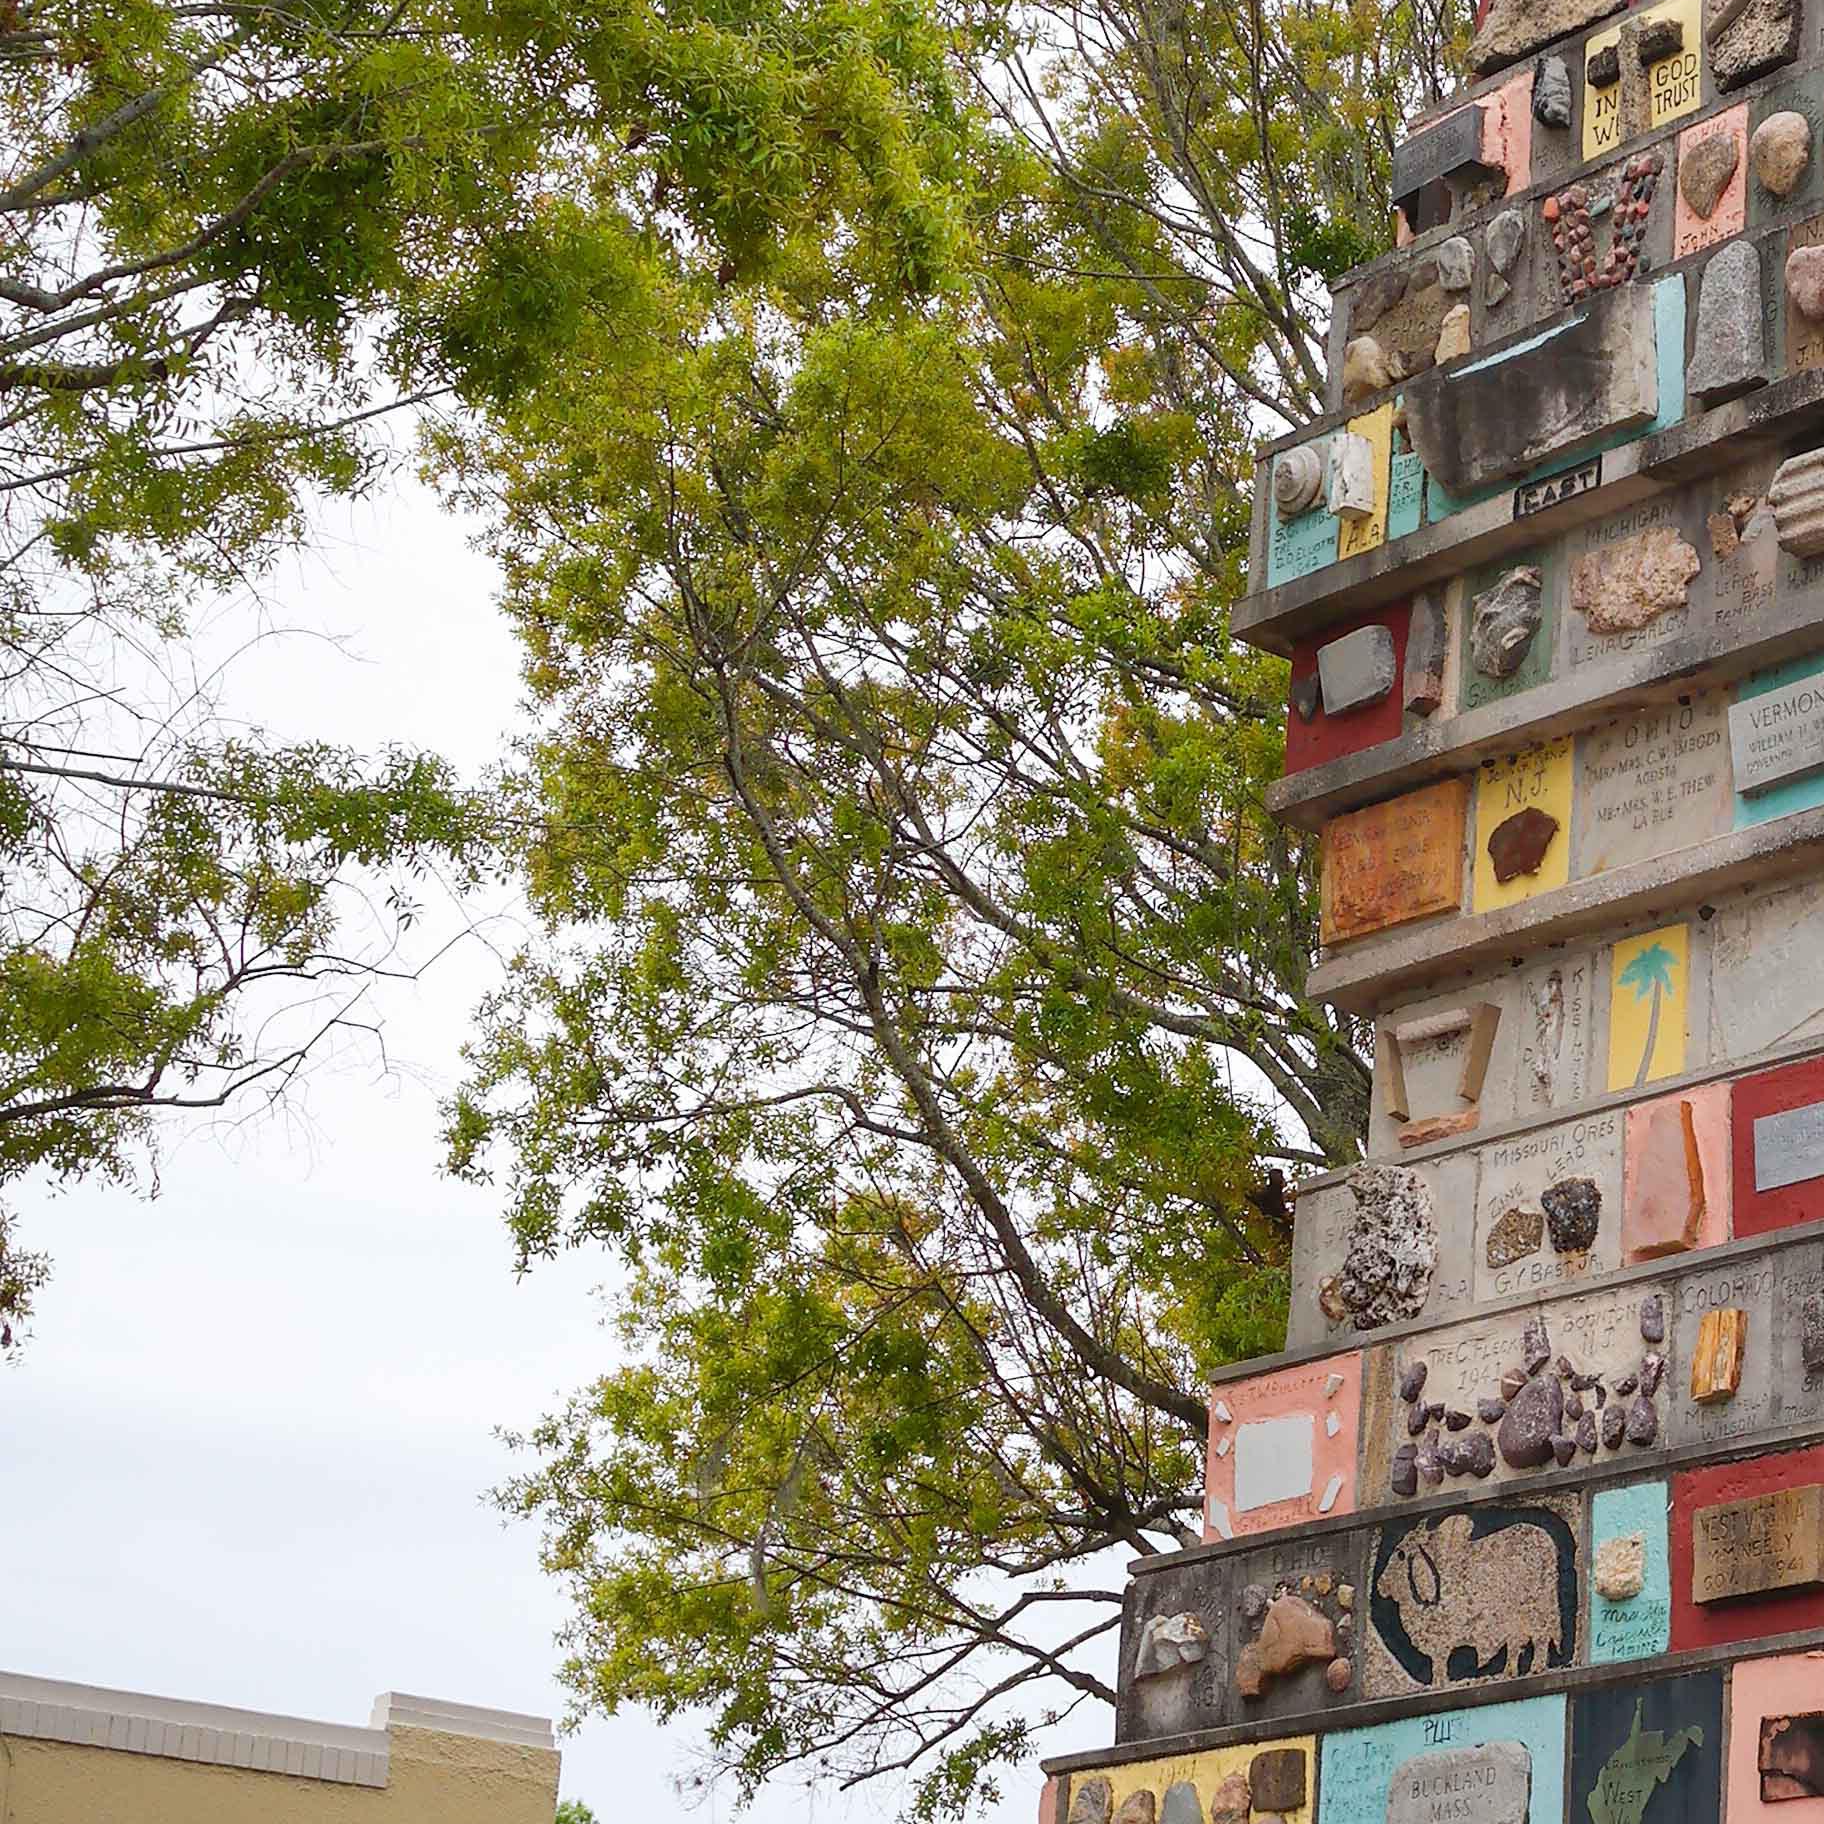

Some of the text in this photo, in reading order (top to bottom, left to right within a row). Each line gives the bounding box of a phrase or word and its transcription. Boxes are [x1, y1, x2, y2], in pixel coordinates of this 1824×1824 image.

[1656, 54, 1697, 87] GOD
[1596, 78, 1698, 118] IN TRUST
[1523, 471, 1593, 511] EAST
[1585, 502, 1673, 544] MICHIGAN
[1624, 707, 1694, 749] OHIO
[1493, 1117, 1615, 1169] MISSOURI ORES
[1546, 1144, 1586, 1183] LEAD
[1681, 1272, 1776, 1314] COLORADO
[1700, 1509, 1740, 1544] WEST
[1410, 1766, 1497, 1800] BUCKLAND
[1602, 1780, 1643, 1807] WEST
